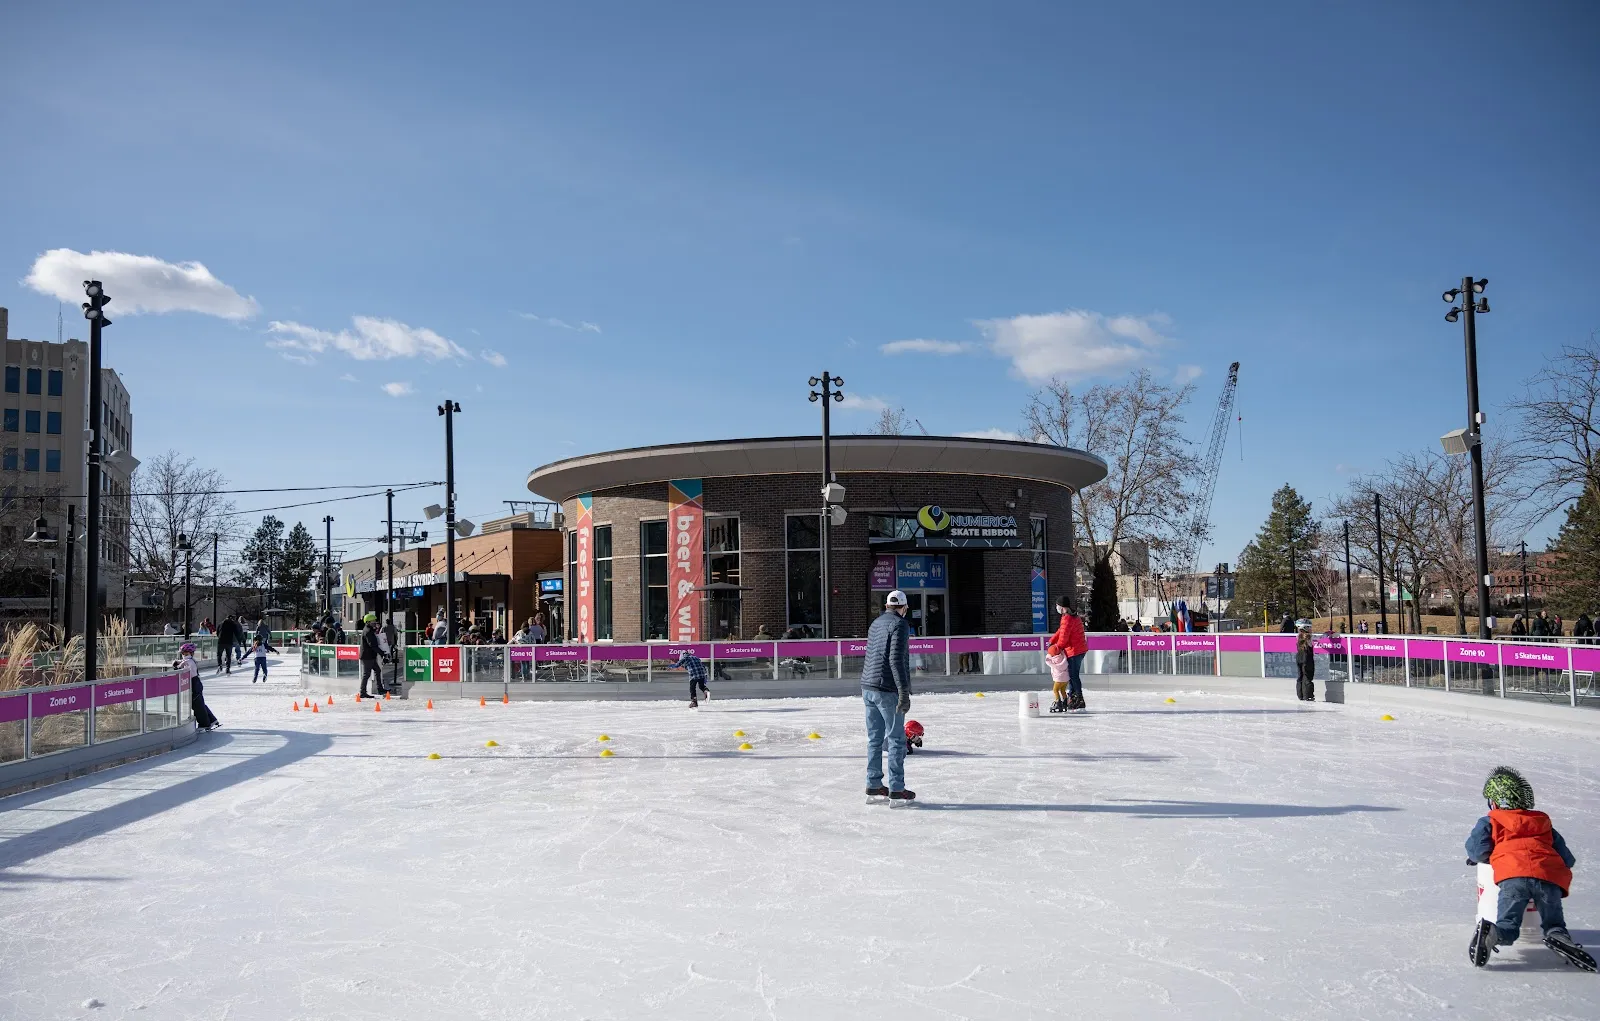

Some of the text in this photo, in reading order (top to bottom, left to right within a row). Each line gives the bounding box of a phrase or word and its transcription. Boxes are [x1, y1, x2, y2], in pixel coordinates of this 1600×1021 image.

[950, 515, 1017, 528] NUMERICA
[950, 528, 1017, 537] SKATE RIBBON
[676, 515, 694, 573] beer
[580, 526, 590, 597] fresh
[905, 561, 921, 570] Café
[898, 570, 928, 578] Entrance
[412, 572, 435, 587] SKYRIDE
[677, 579, 695, 600] &
[1313, 641, 1333, 649] Zone
[1364, 643, 1384, 651] Skaters
[1459, 647, 1486, 658] Zone 10
[1514, 652, 1555, 661] 5 Skaters Max
[408, 659, 429, 668] ENTER
[438, 658, 454, 667] EXIT
[108, 689, 125, 698] Skaters
[125, 687, 134, 695] Max
[49, 695, 77, 707] Zone 10
